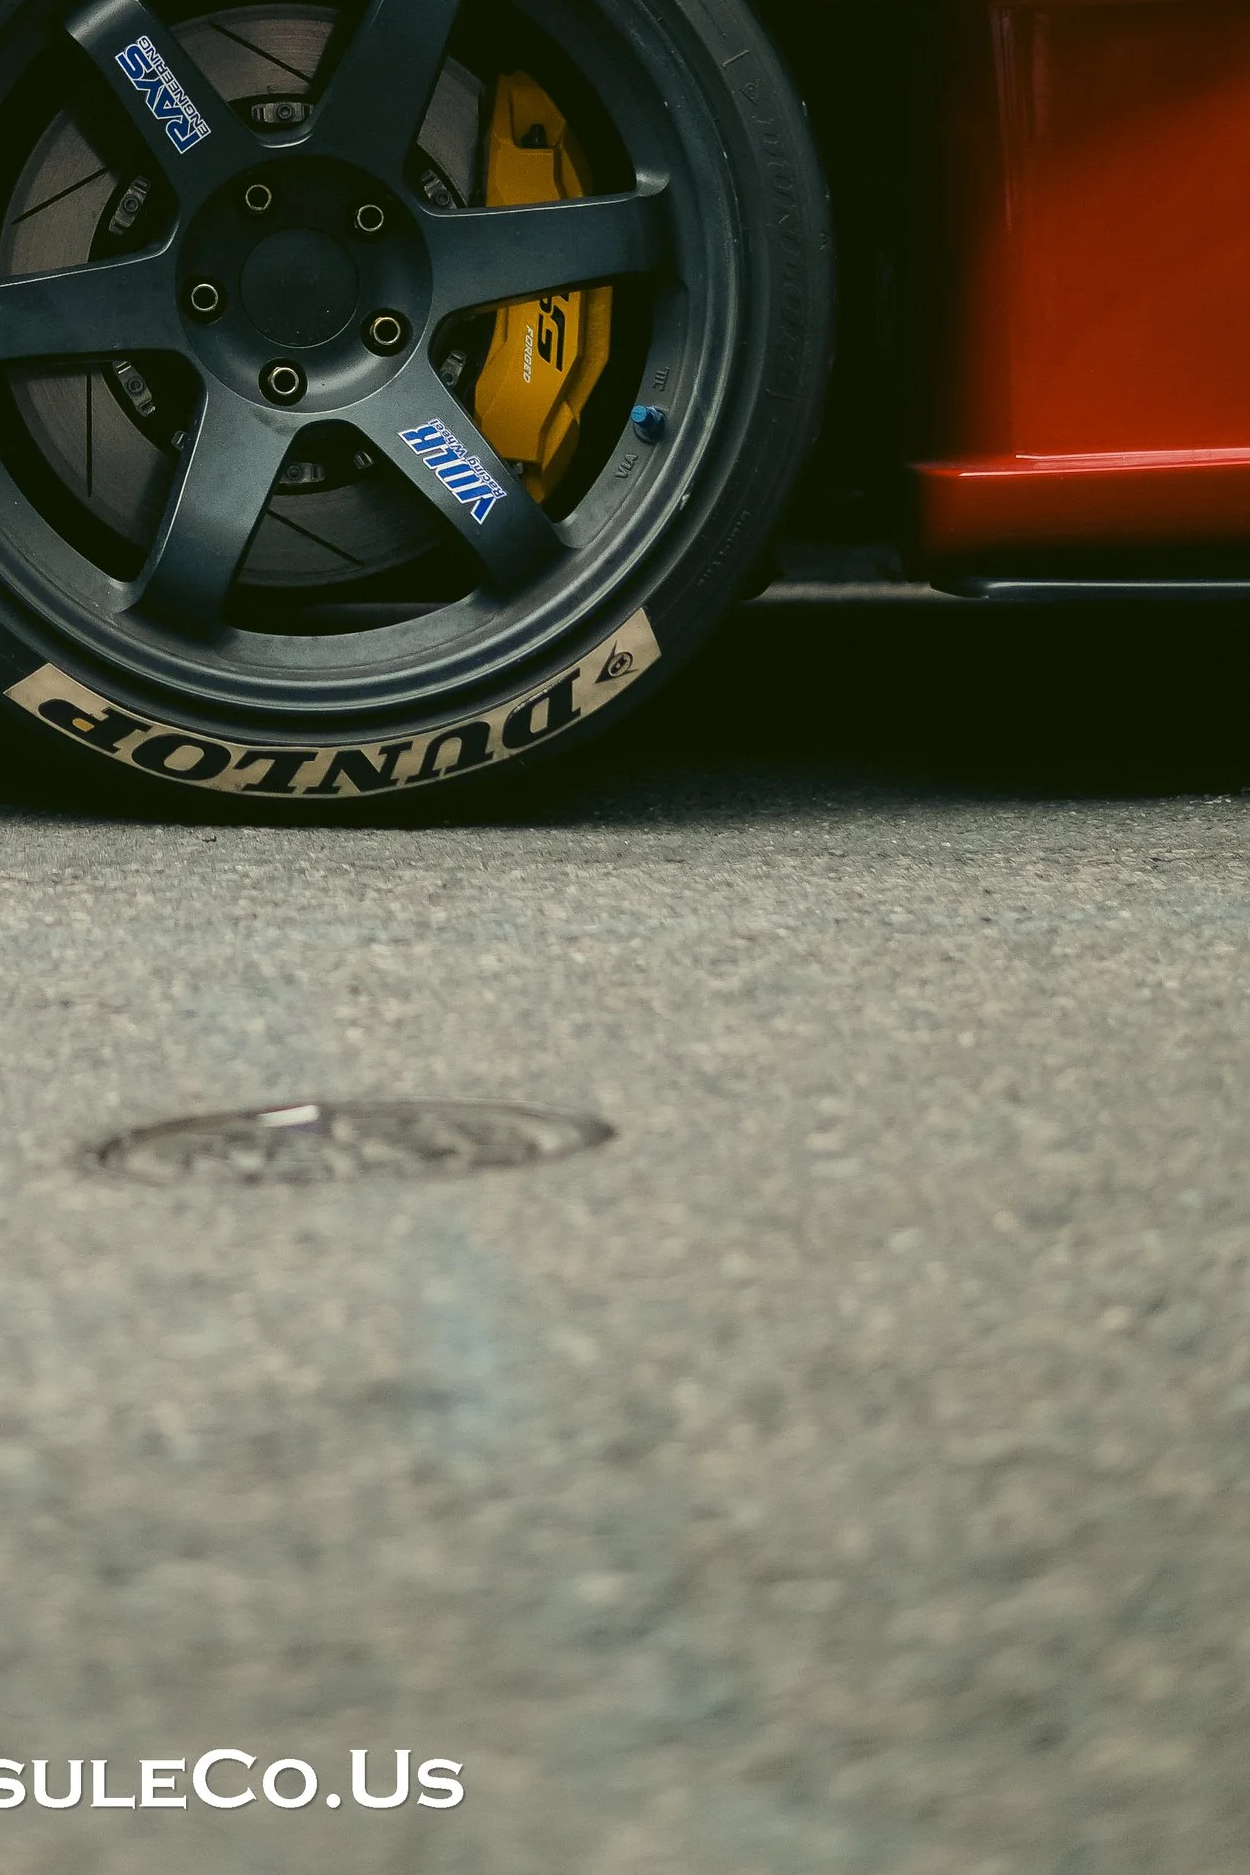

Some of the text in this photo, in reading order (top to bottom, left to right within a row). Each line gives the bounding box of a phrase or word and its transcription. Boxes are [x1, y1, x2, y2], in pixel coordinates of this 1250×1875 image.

[115, 43, 201, 154] RAYS
[138, 35, 211, 139] ENGINEERING
[523, 324, 534, 383] FORGED
[428, 418, 508, 500] Racing Wheel
[37, 666, 587, 796] DUNLOP
